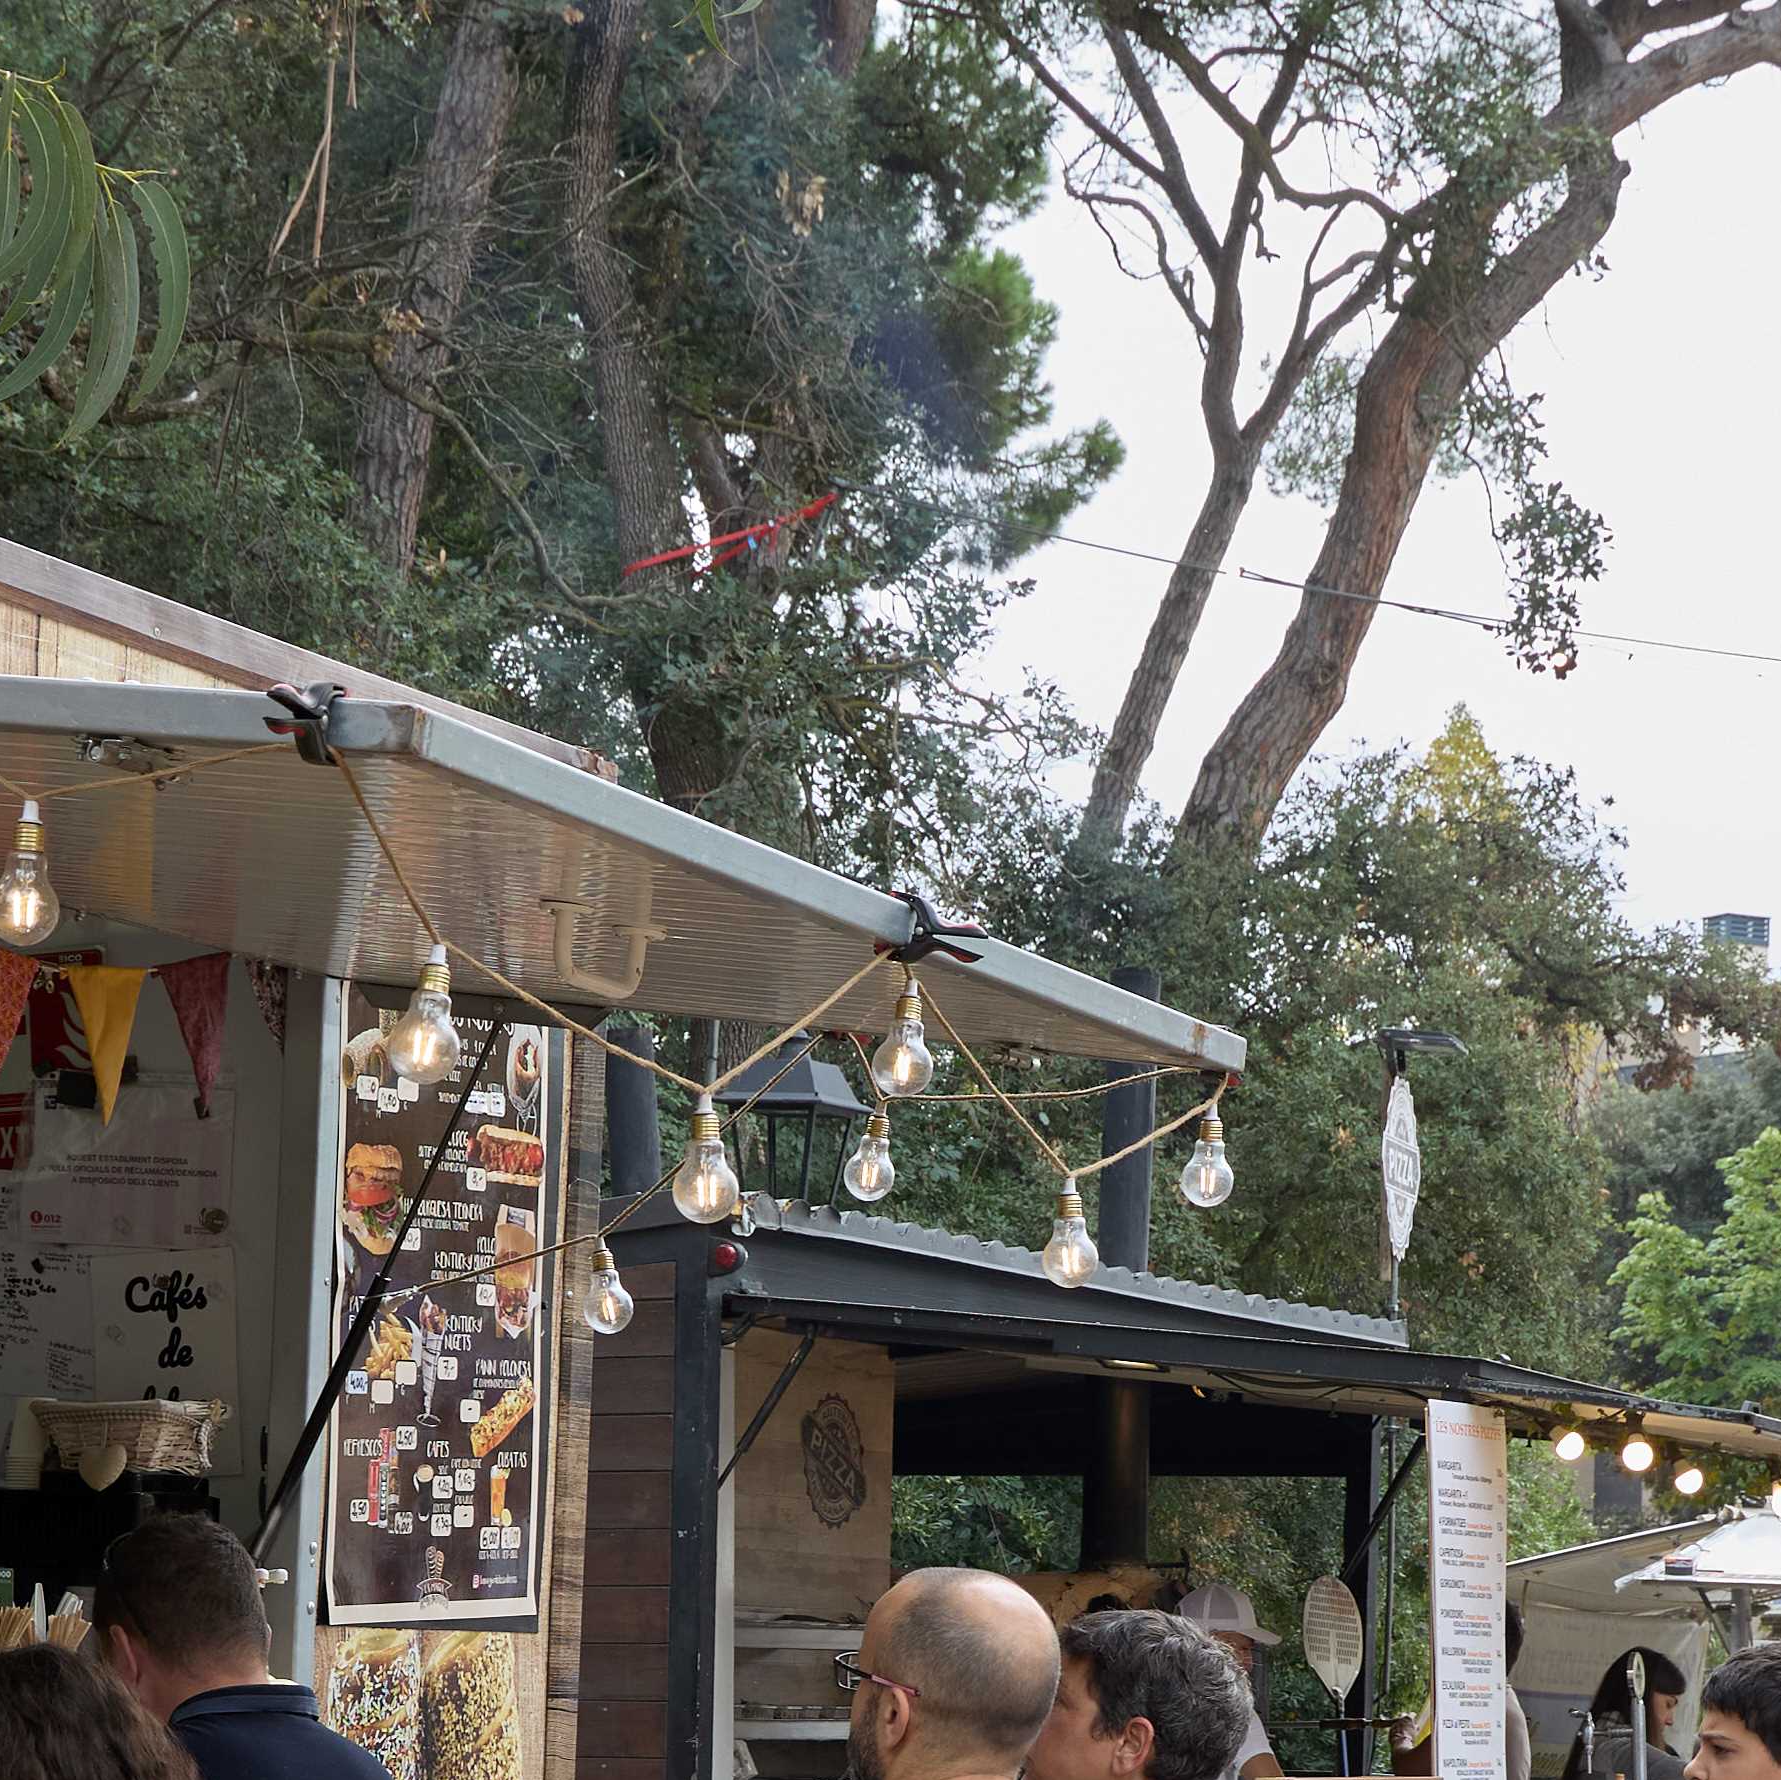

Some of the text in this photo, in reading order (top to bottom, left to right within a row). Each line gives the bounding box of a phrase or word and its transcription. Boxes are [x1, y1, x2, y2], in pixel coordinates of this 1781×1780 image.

[43, 1213, 61, 1224] 012
[124, 1269, 209, 1323] Cafés
[157, 1326, 195, 1369] de
[497, 1451, 528, 1469] CUBATAS
[809, 1427, 856, 1499] PIZZA
